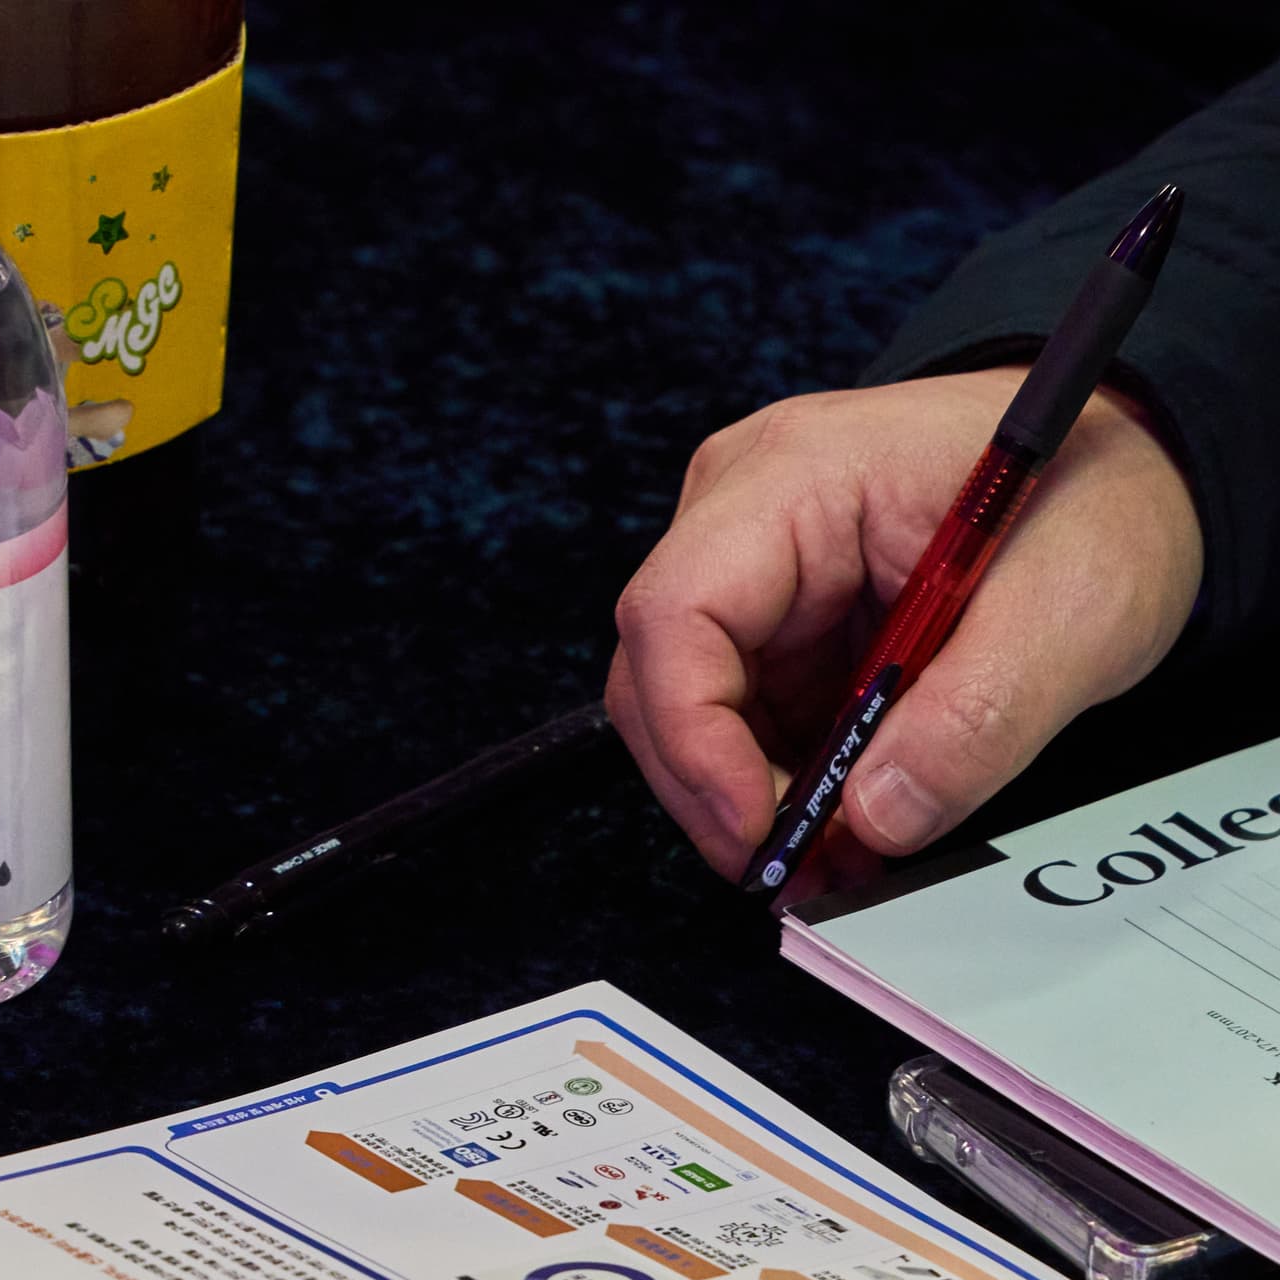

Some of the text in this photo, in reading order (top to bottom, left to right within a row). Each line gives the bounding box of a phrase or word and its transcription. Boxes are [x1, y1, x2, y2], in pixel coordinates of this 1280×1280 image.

[840, 725, 863, 758] Jet
[829, 754, 849, 782] 3
[806, 774, 835, 819] Ball
[786, 819, 811, 850] KOREA
[453, 1146, 488, 1166] ISO
[640, 1142, 678, 1168] CATL
